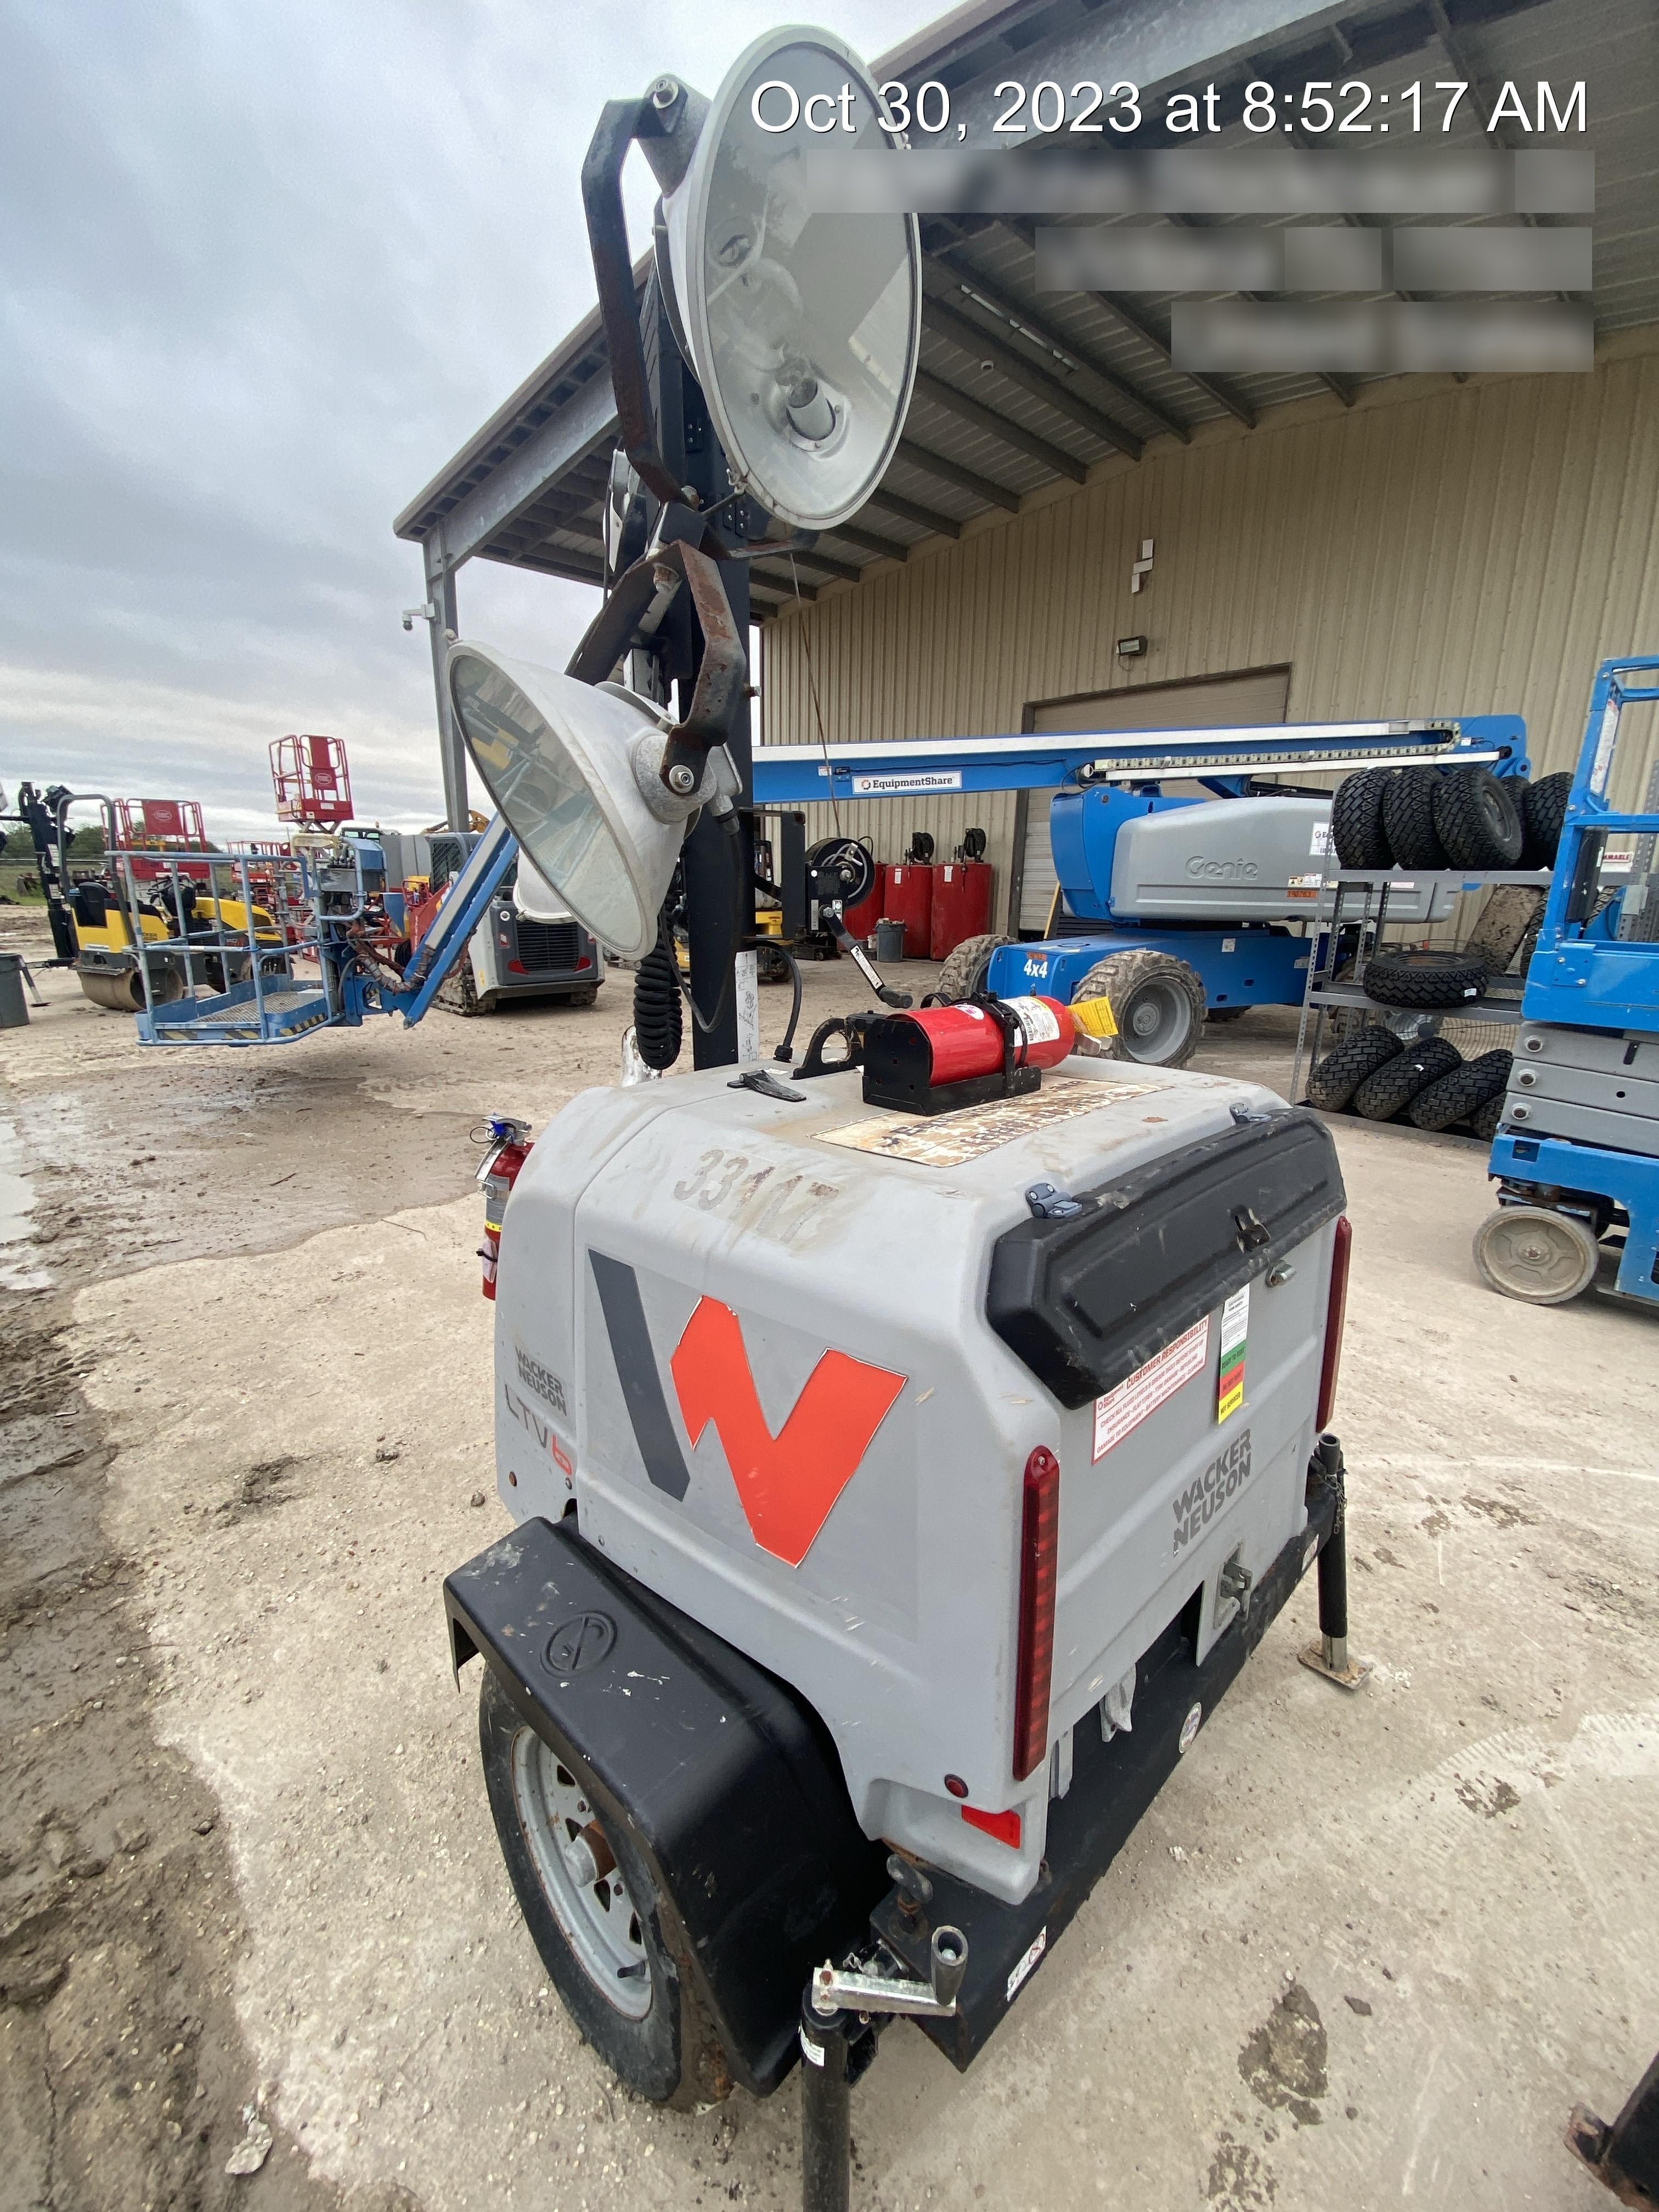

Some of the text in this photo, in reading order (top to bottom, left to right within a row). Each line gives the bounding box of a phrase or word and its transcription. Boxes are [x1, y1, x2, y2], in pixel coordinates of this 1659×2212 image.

[873, 777, 953, 790] EquipmentShare
[1185, 855, 1259, 880] Genie
[1023, 958, 1048, 979] 4x4
[515, 1345, 565, 1400] WACKER
[1126, 1355, 1161, 1390] CUSTOMER
[1161, 1318, 1208, 1362] RESPONSIBILITY
[517, 1362, 567, 1417] NEUSON
[1101, 1412, 1115, 1428] CHECK
[1115, 1429, 1121, 1438] TO
[1121, 1409, 1144, 1433] EQUIPMENT
[1146, 1393, 1161, 1412] BATTERY
[1172, 1429, 1251, 1523] WACKER
[1172, 1452, 1251, 1558] NEUSON
